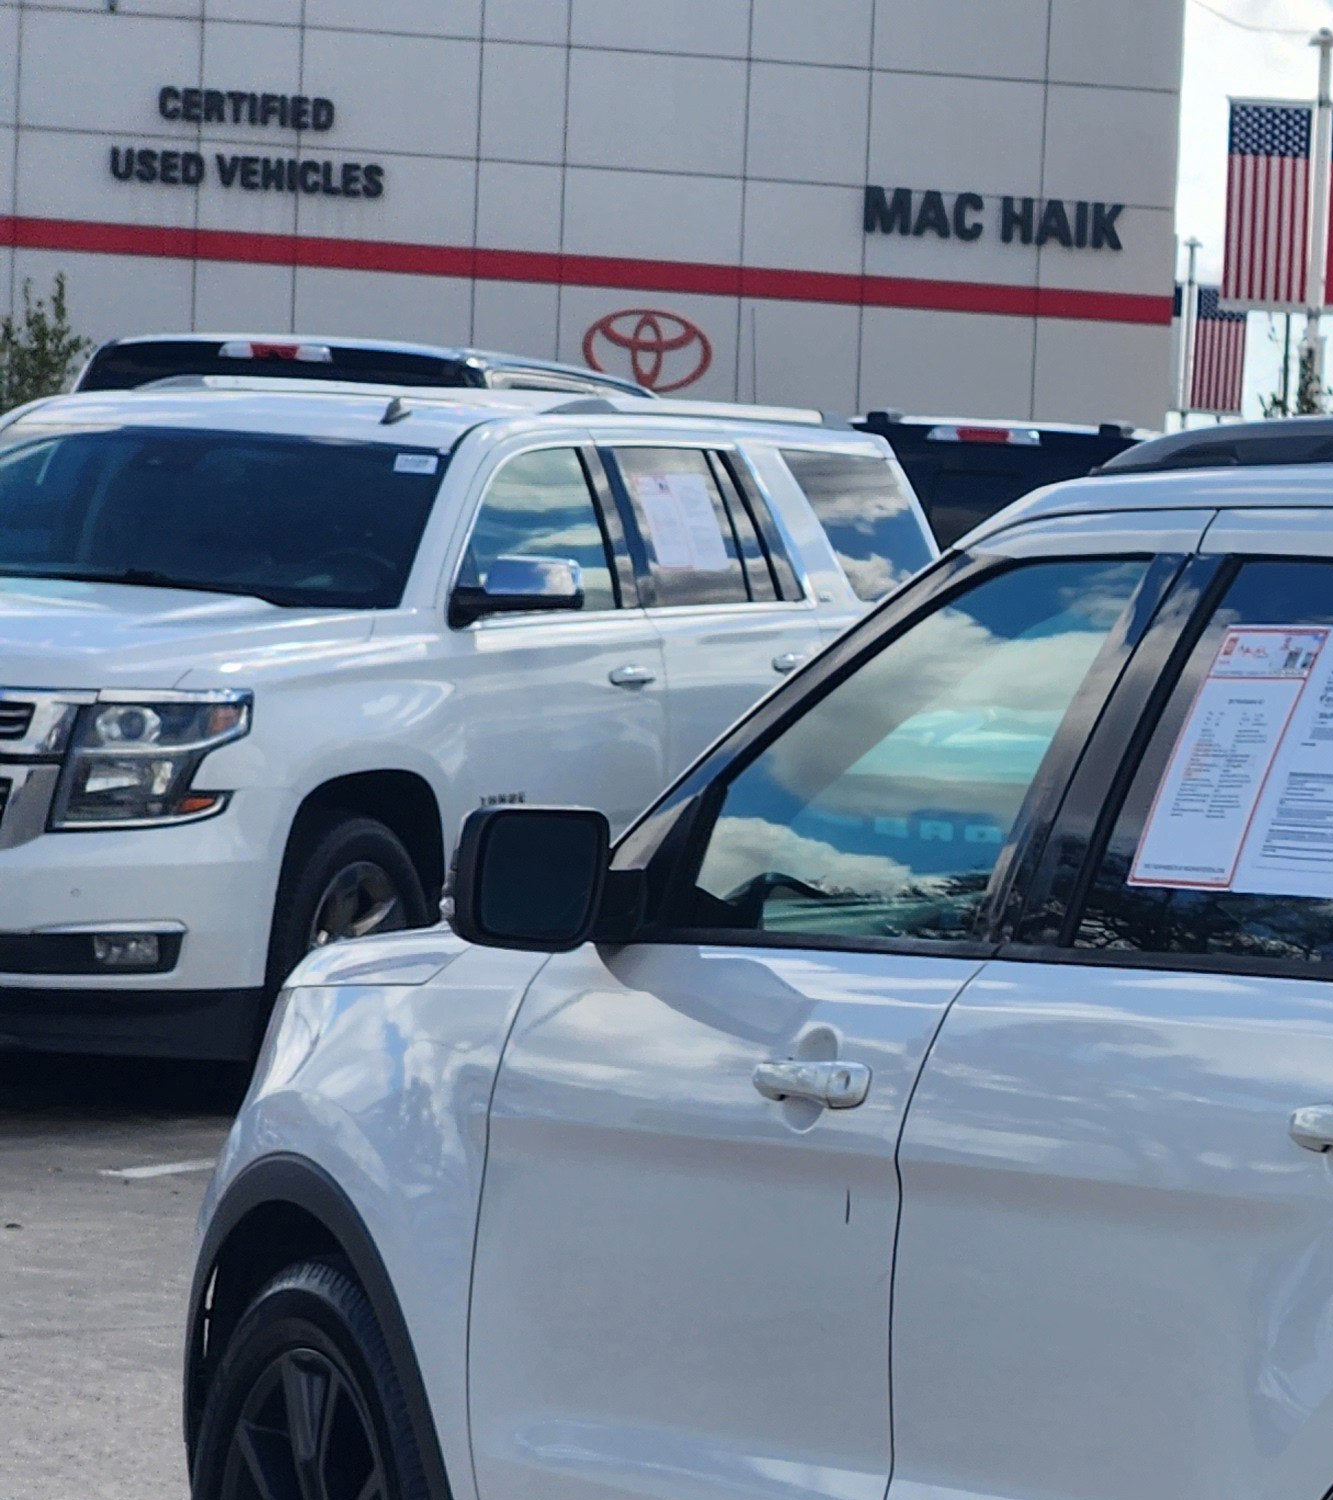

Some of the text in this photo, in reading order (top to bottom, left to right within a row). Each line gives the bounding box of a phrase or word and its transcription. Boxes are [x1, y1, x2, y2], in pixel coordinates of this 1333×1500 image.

[158, 85, 335, 132] CERTIFIED
[110, 146, 385, 199] USED VEHICLES
[864, 185, 1126, 250] MAC HAIK
